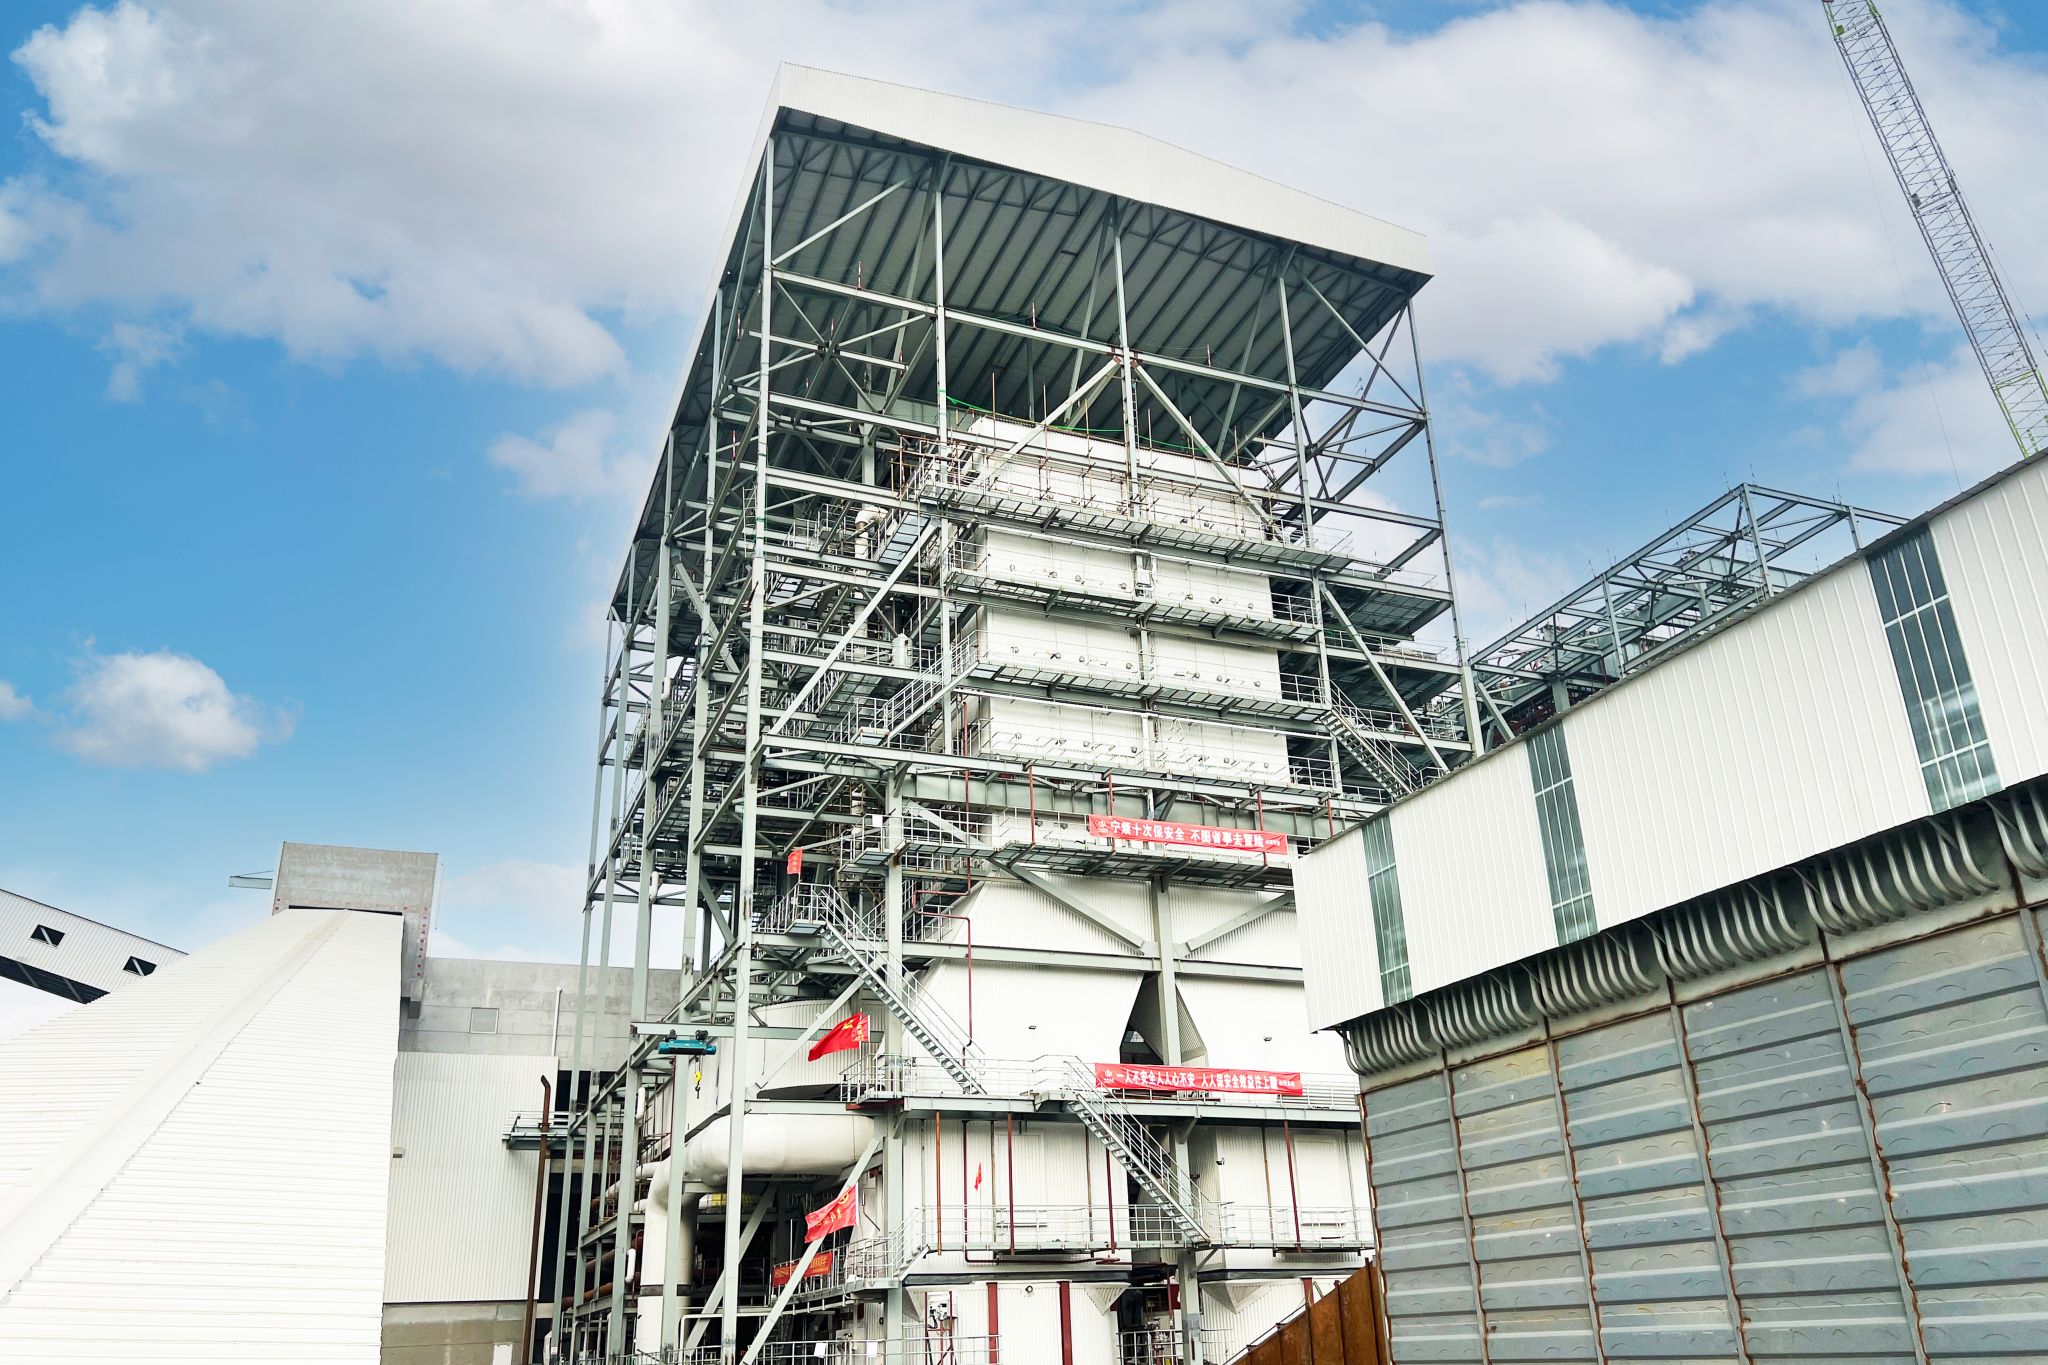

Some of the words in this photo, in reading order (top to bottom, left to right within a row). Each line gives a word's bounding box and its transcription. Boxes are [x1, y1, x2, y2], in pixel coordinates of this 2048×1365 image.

[1116, 1069, 1195, 1087] 一人不安全人人心不安
